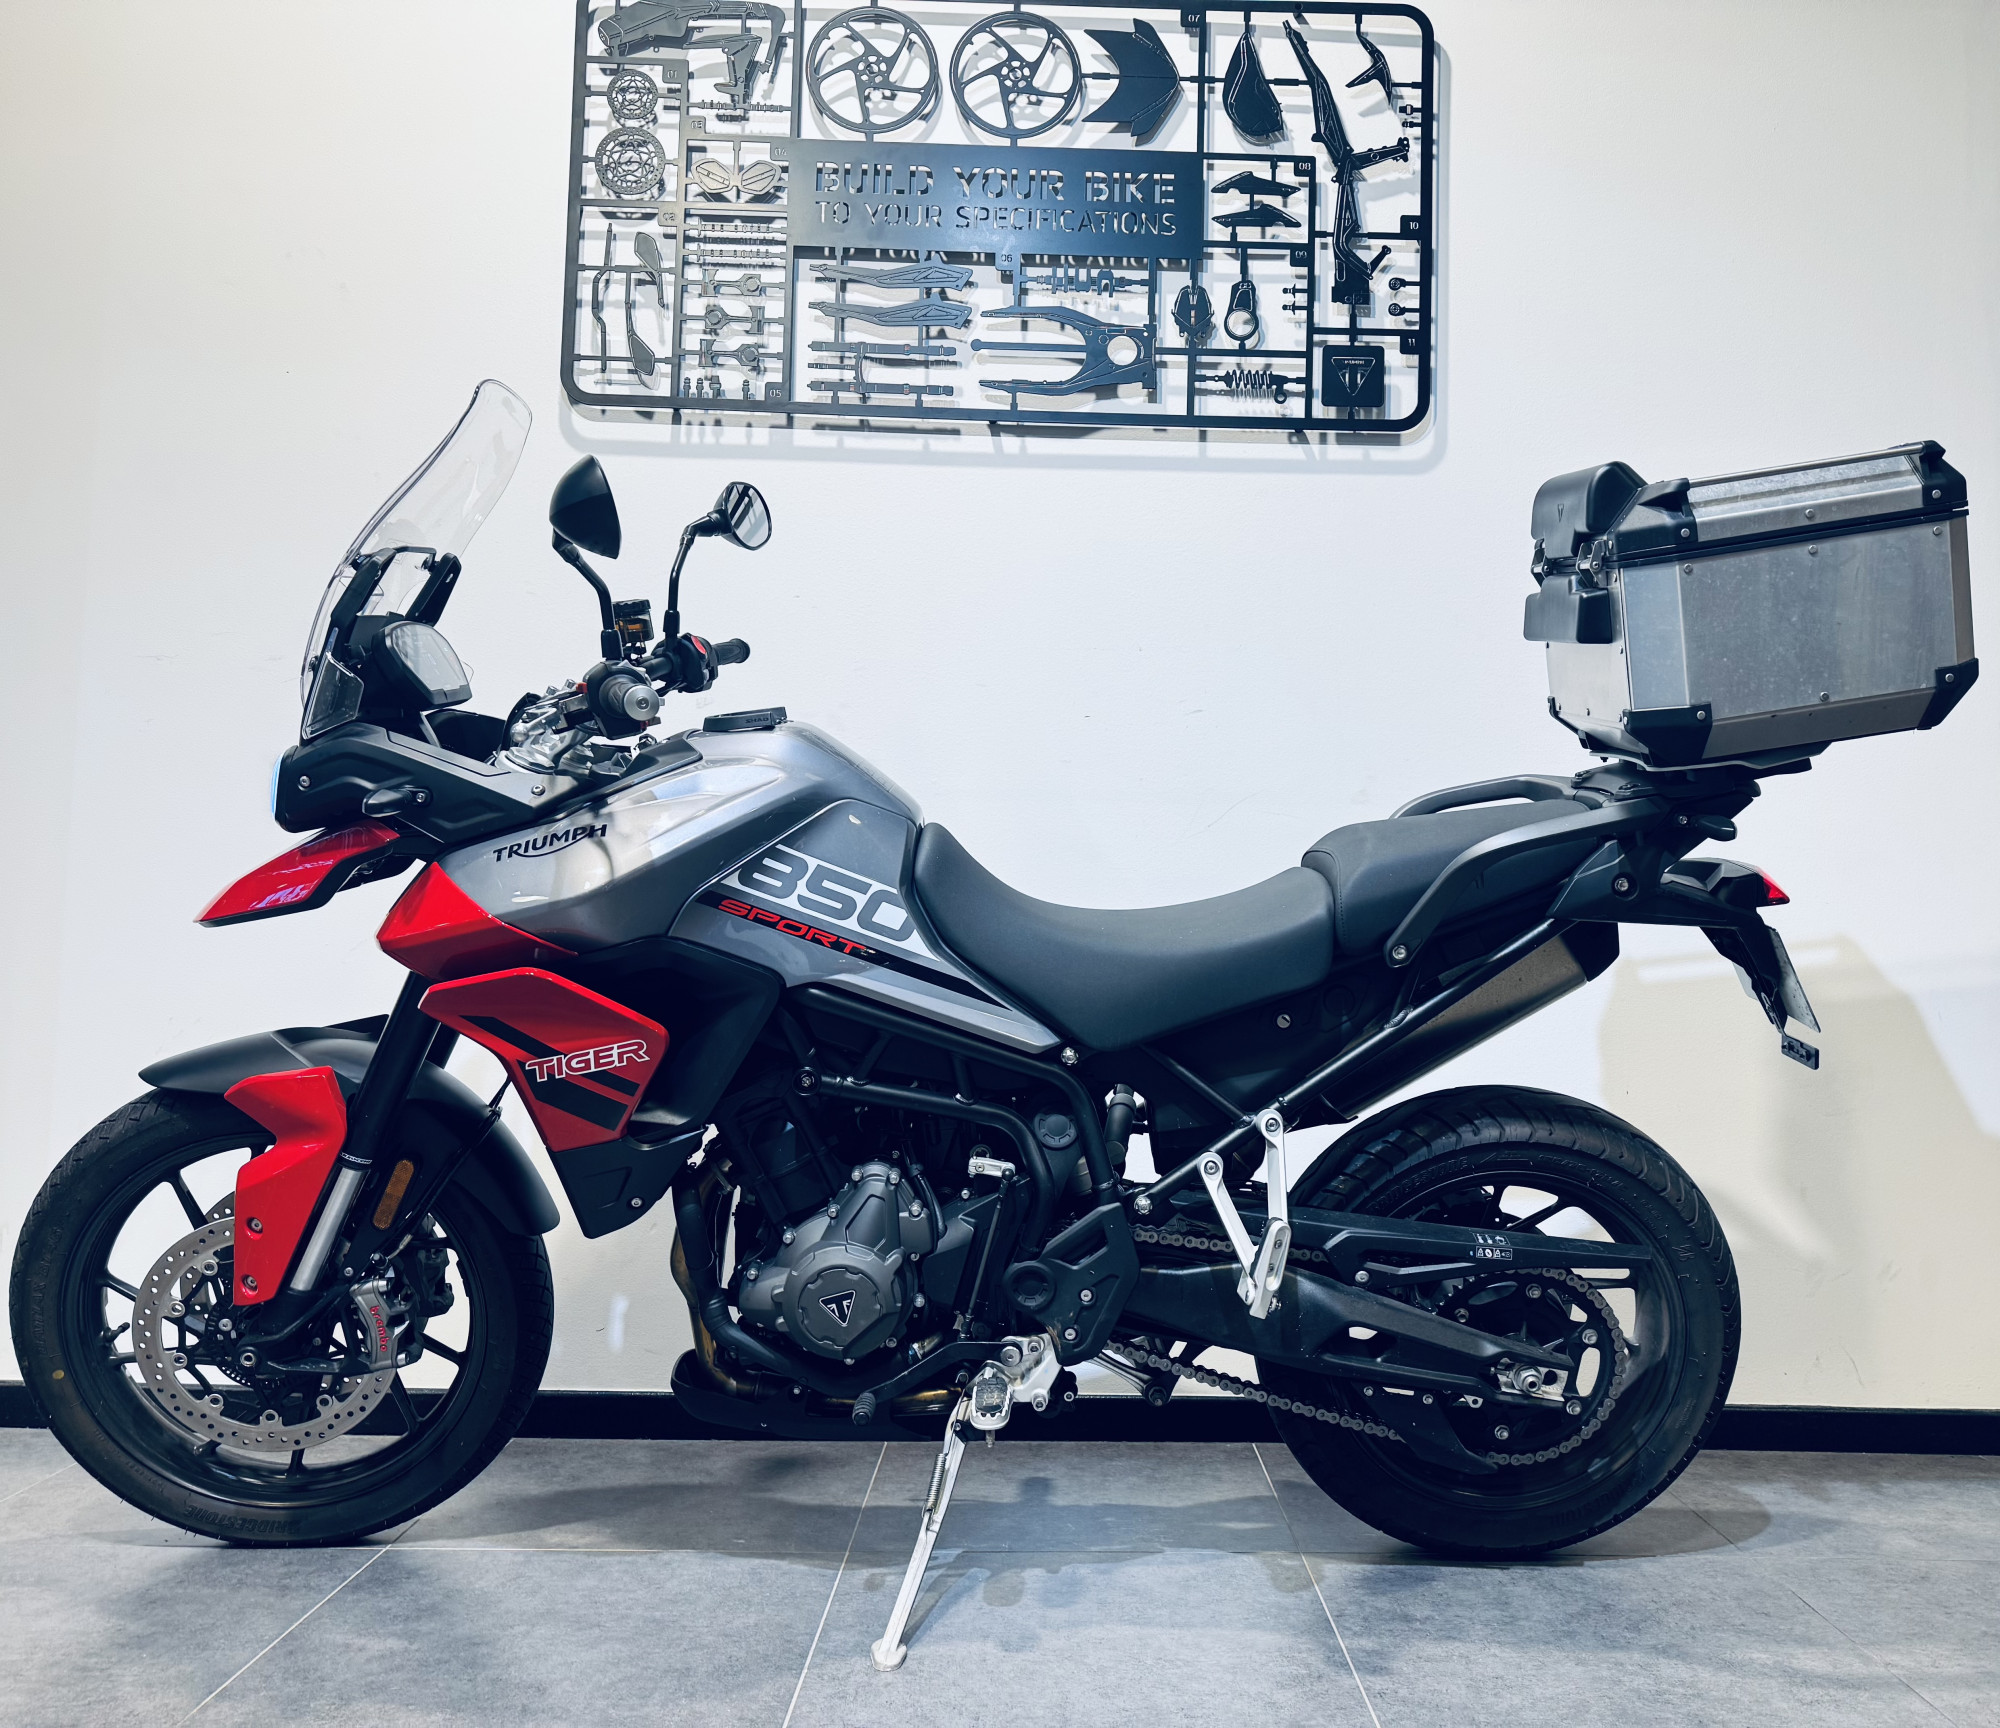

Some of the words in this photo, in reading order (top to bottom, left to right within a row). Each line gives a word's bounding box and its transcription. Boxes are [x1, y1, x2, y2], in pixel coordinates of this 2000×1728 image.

[1188, 14, 1200, 23] 07
[667, 70, 677, 79] 01
[775, 147, 787, 156] 04
[1298, 162, 1311, 171] 08
[815, 160, 935, 196] BUILD
[952, 165, 1065, 201] YOUR
[1084, 170, 1176, 204] BIKE
[662, 212, 676, 222] 02
[815, 200, 850, 225] TO
[864, 202, 942, 229] YOUR
[955, 204, 1178, 237] SPECIFICATIONS
[1409, 221, 1419, 230] 10
[1000, 253, 1013, 263] 06
[1295, 250, 1307, 259] 09
[1408, 338, 1416, 347] 11
[769, 389, 782, 398] 05
[744, 716, 769, 724] SHAD
[493, 824, 608, 862] TRIUMPH
[737, 848, 915, 942] 850
[718, 898, 866, 955] SPORT
[525, 1039, 651, 1083] TIGER
[370, 1305, 391, 1352] brembo
[183, 1505, 303, 1536] BRIDGESTONE
